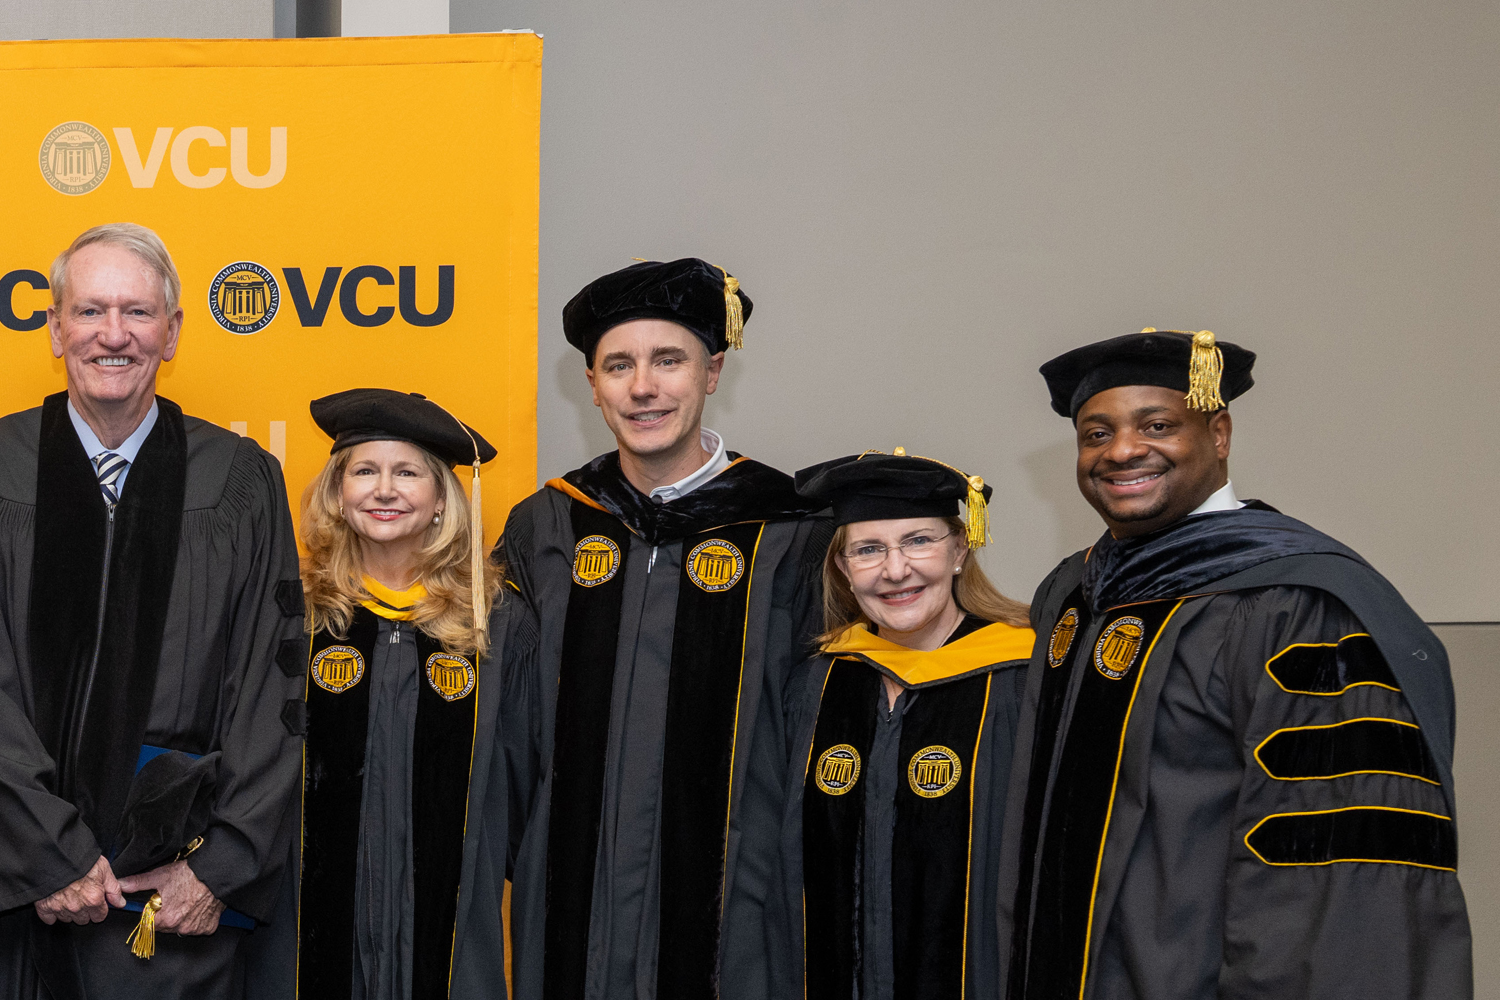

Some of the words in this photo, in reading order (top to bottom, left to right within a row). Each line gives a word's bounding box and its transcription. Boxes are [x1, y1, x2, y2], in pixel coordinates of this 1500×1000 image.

[43, 124, 100, 152] COMMONWEALTH
[113, 126, 287, 188] VCU
[42, 155, 60, 189] VIRGINIA
[90, 142, 108, 188] UNIVERSITY
[212, 264, 271, 291] COMMONWEALTH
[282, 265, 455, 327] VCU
[211, 294, 229, 328] VIRGINIA
[259, 282, 277, 327] UNIVERSITY
